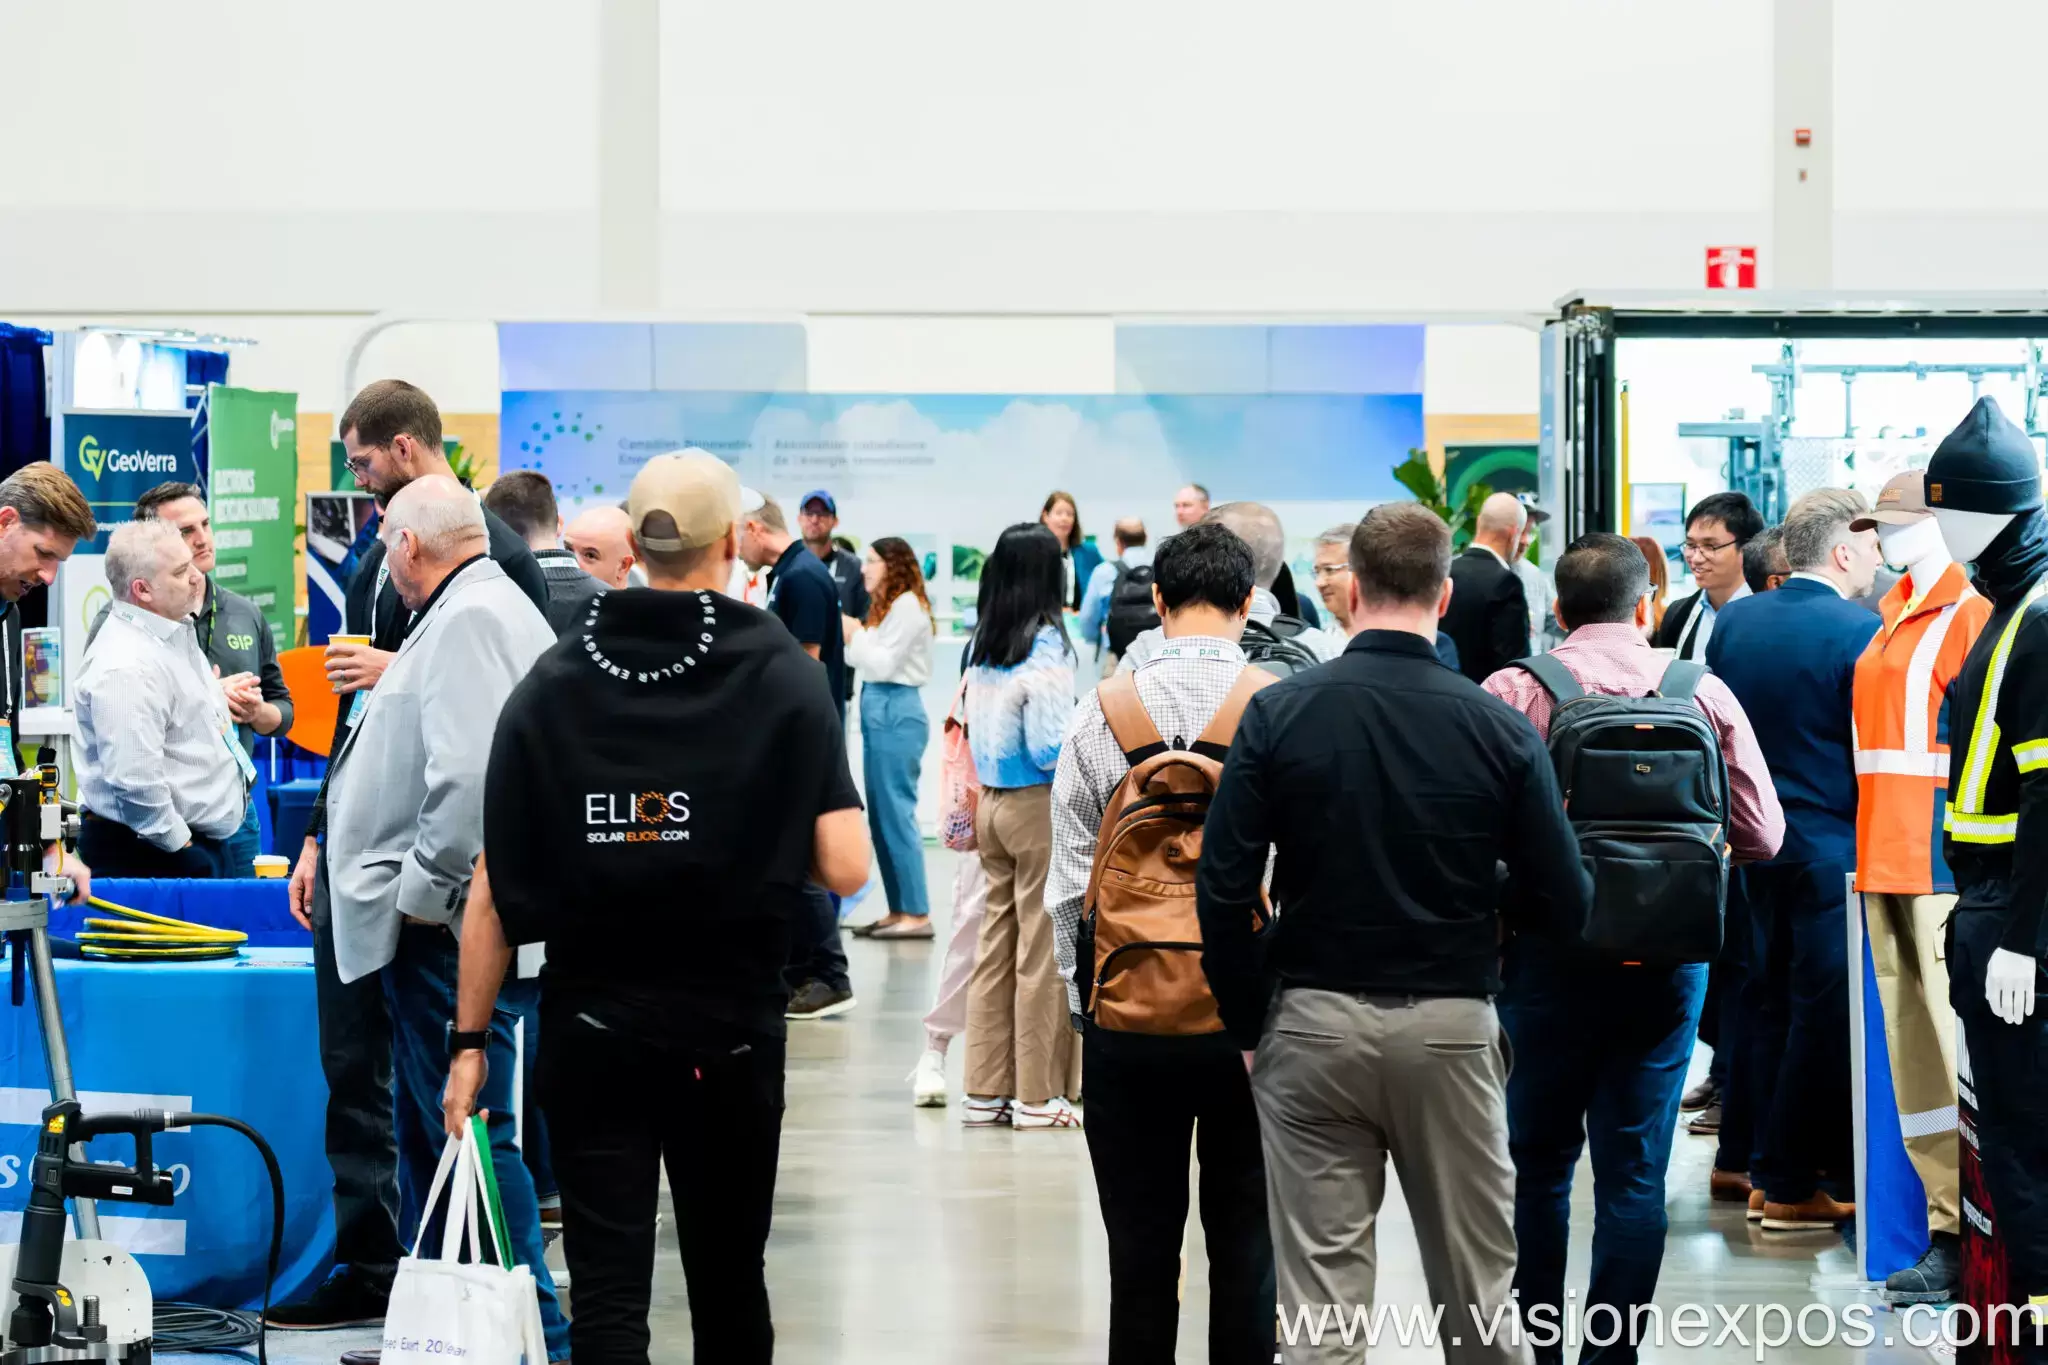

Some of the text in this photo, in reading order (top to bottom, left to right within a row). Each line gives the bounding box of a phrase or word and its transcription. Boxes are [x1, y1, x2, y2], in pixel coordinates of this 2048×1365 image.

[107, 449, 177, 473] GeoVerra
[226, 634, 254, 651] GIP
[697, 632, 714, 654] OF
[582, 634, 631, 681] ENERGY
[637, 655, 696, 683] SOLAR
[585, 791, 690, 825] ELIOS
[586, 830, 690, 844] SOLARELIOS.COM
